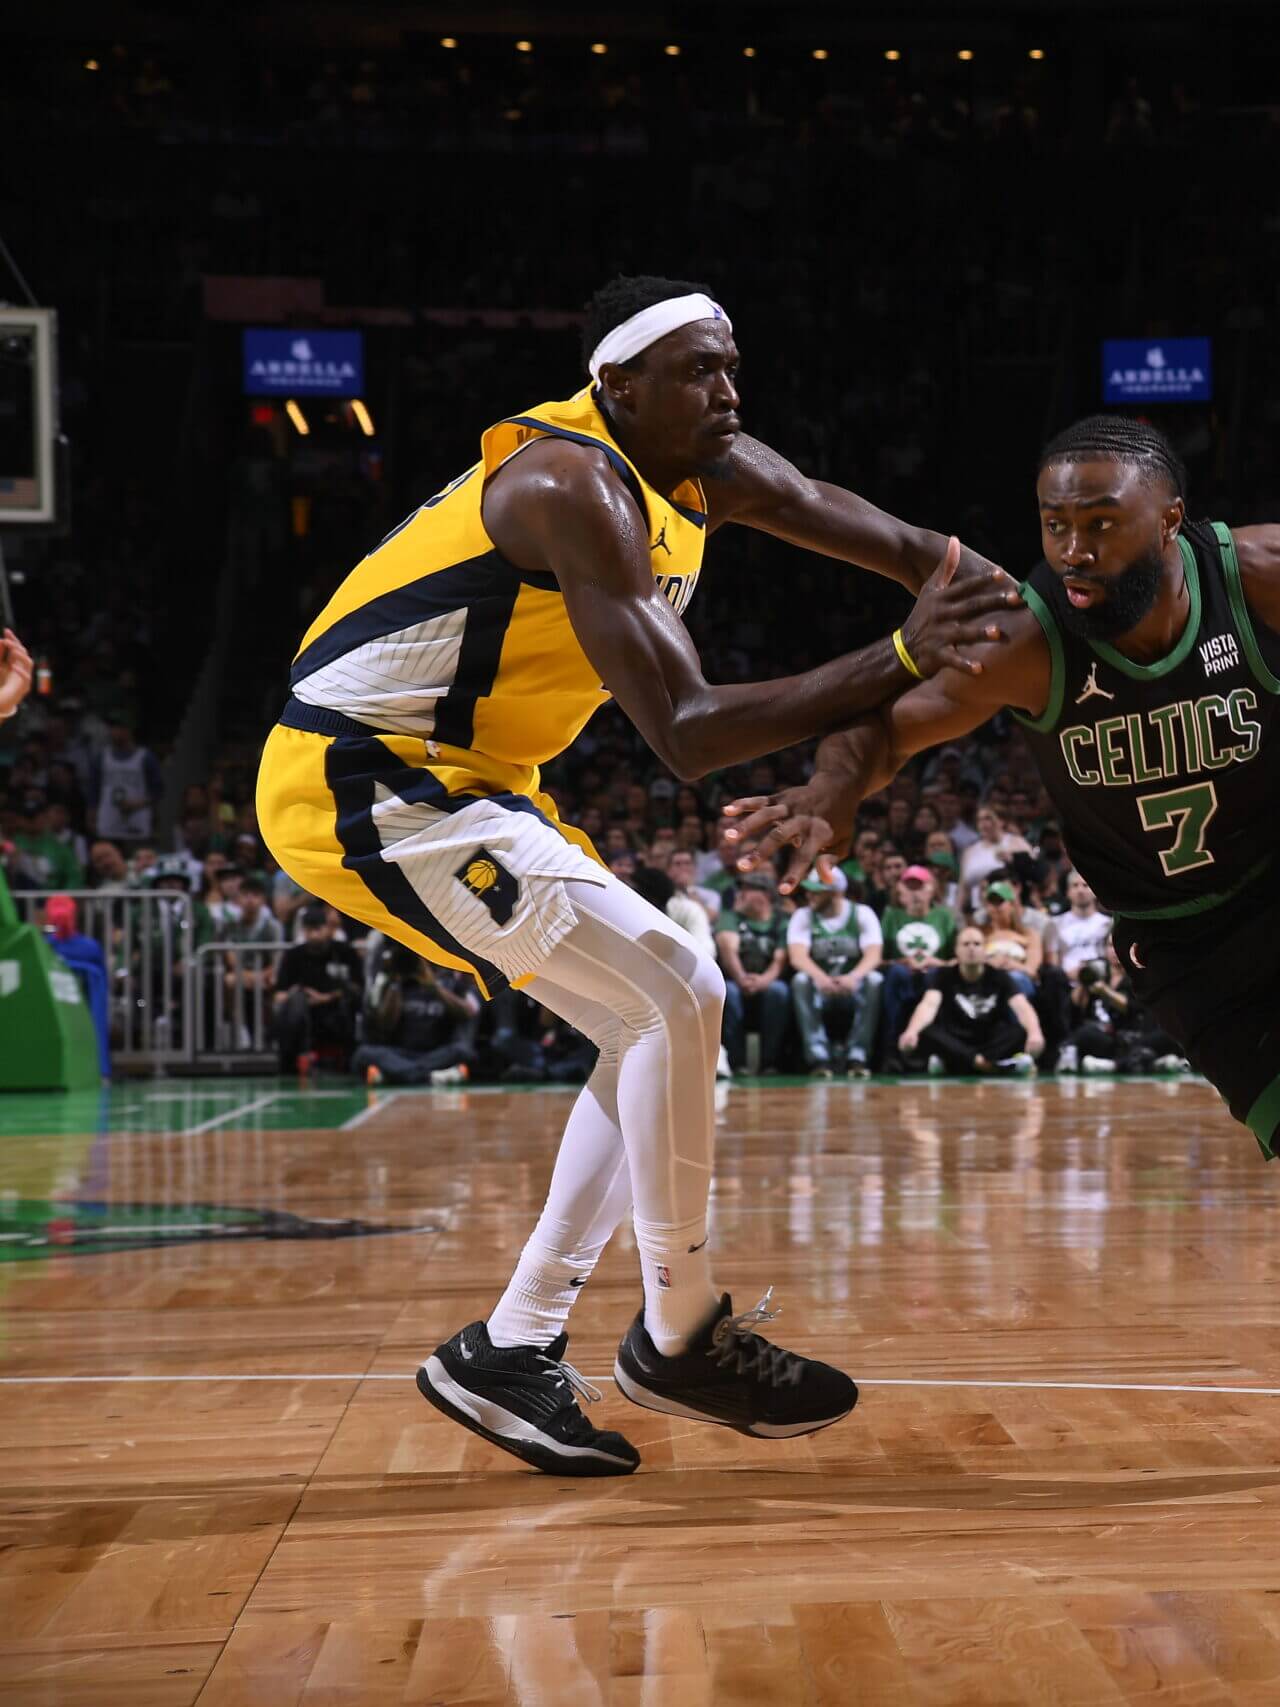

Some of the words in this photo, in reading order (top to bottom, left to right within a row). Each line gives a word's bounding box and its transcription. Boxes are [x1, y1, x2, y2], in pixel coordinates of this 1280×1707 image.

[1199, 633, 1237, 663] VISTA
[1204, 650, 1239, 678] PRINT
[1059, 688, 1261, 786] CELTICS
[1136, 781, 1218, 877] 7
